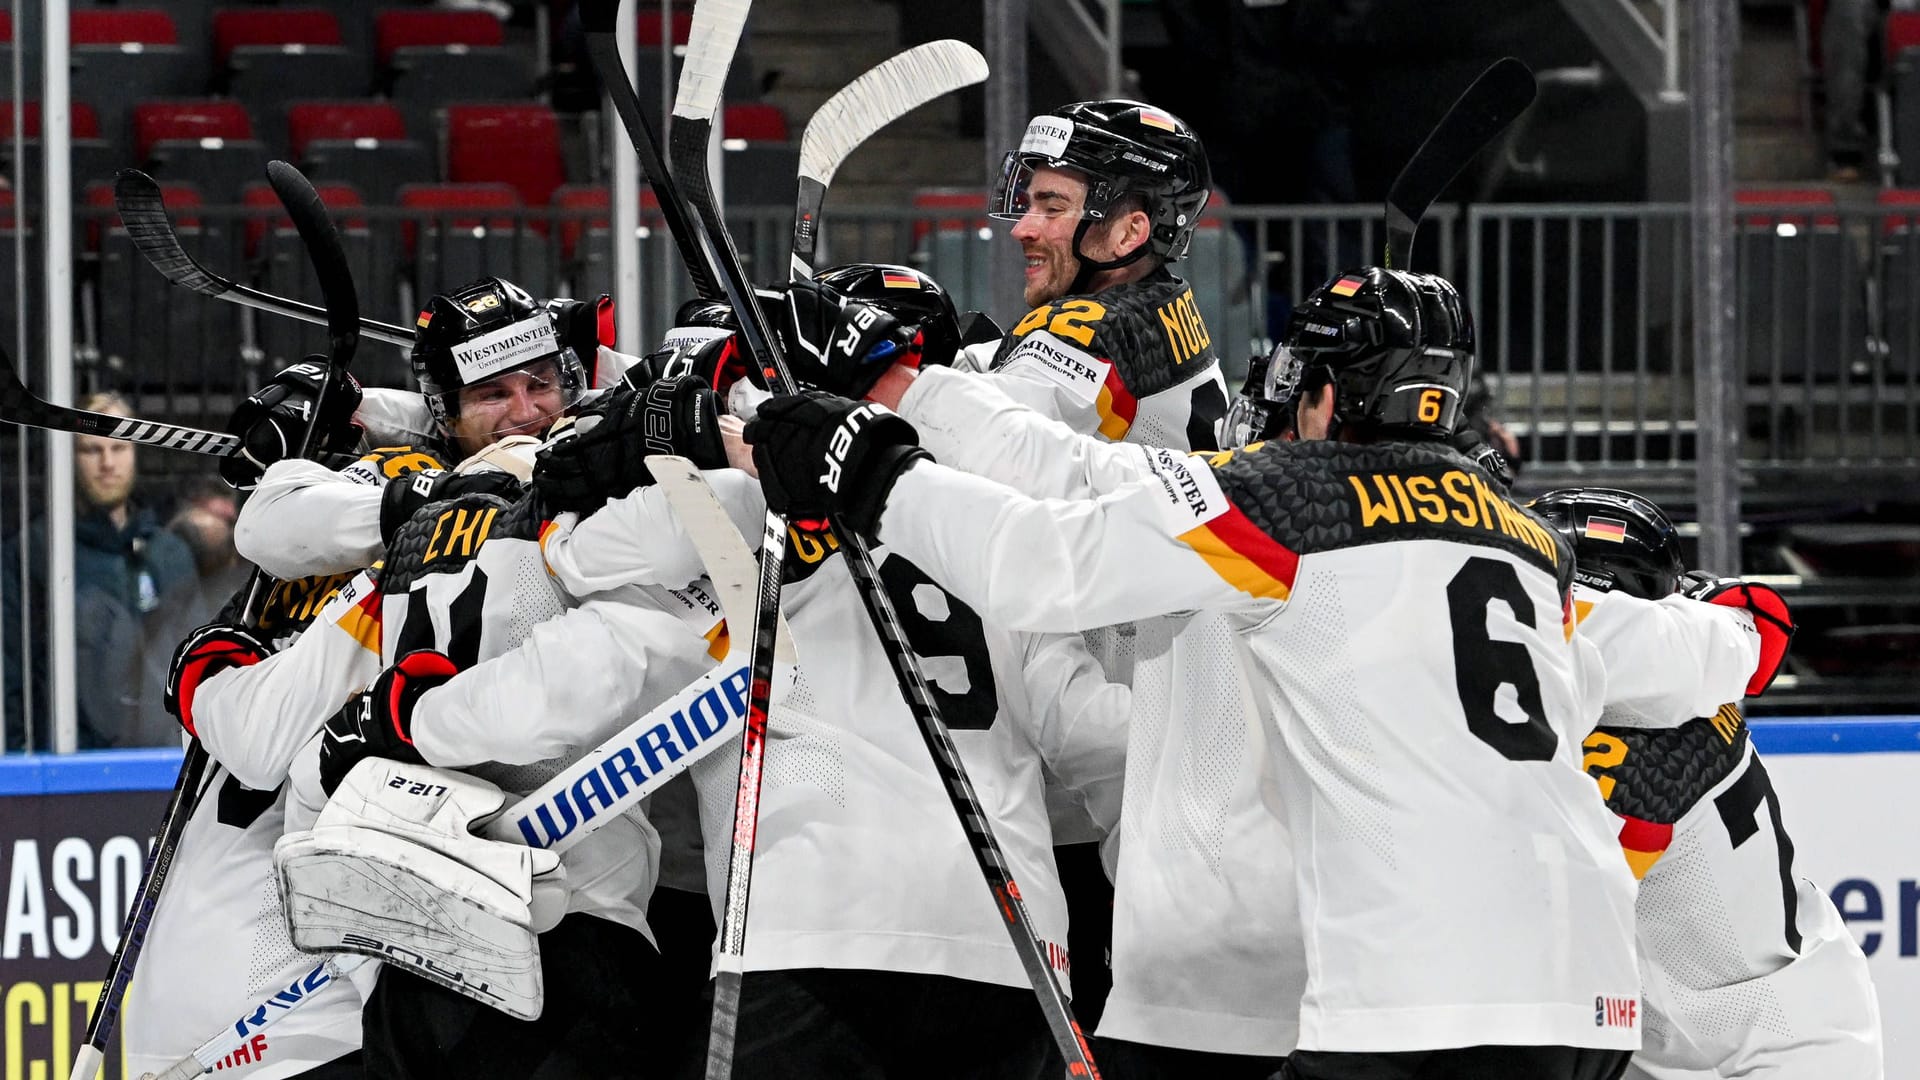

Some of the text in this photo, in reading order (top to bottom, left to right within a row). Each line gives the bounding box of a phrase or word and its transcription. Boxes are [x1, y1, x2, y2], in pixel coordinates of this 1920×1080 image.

[458, 323, 551, 366] WESTMINSTER
[477, 341, 544, 371] UNTERNEHMENSGRUPPE
[1010, 340, 1097, 383] MINSTER
[1418, 389, 1442, 422] 6
[108, 418, 242, 457] WAR
[1446, 555, 1559, 762] 6
[1582, 731, 1630, 801] 2
[151, 844, 174, 895] TRIGGER
[0, 836, 157, 960] ASO
[1606, 997, 1637, 1029] IIHF
